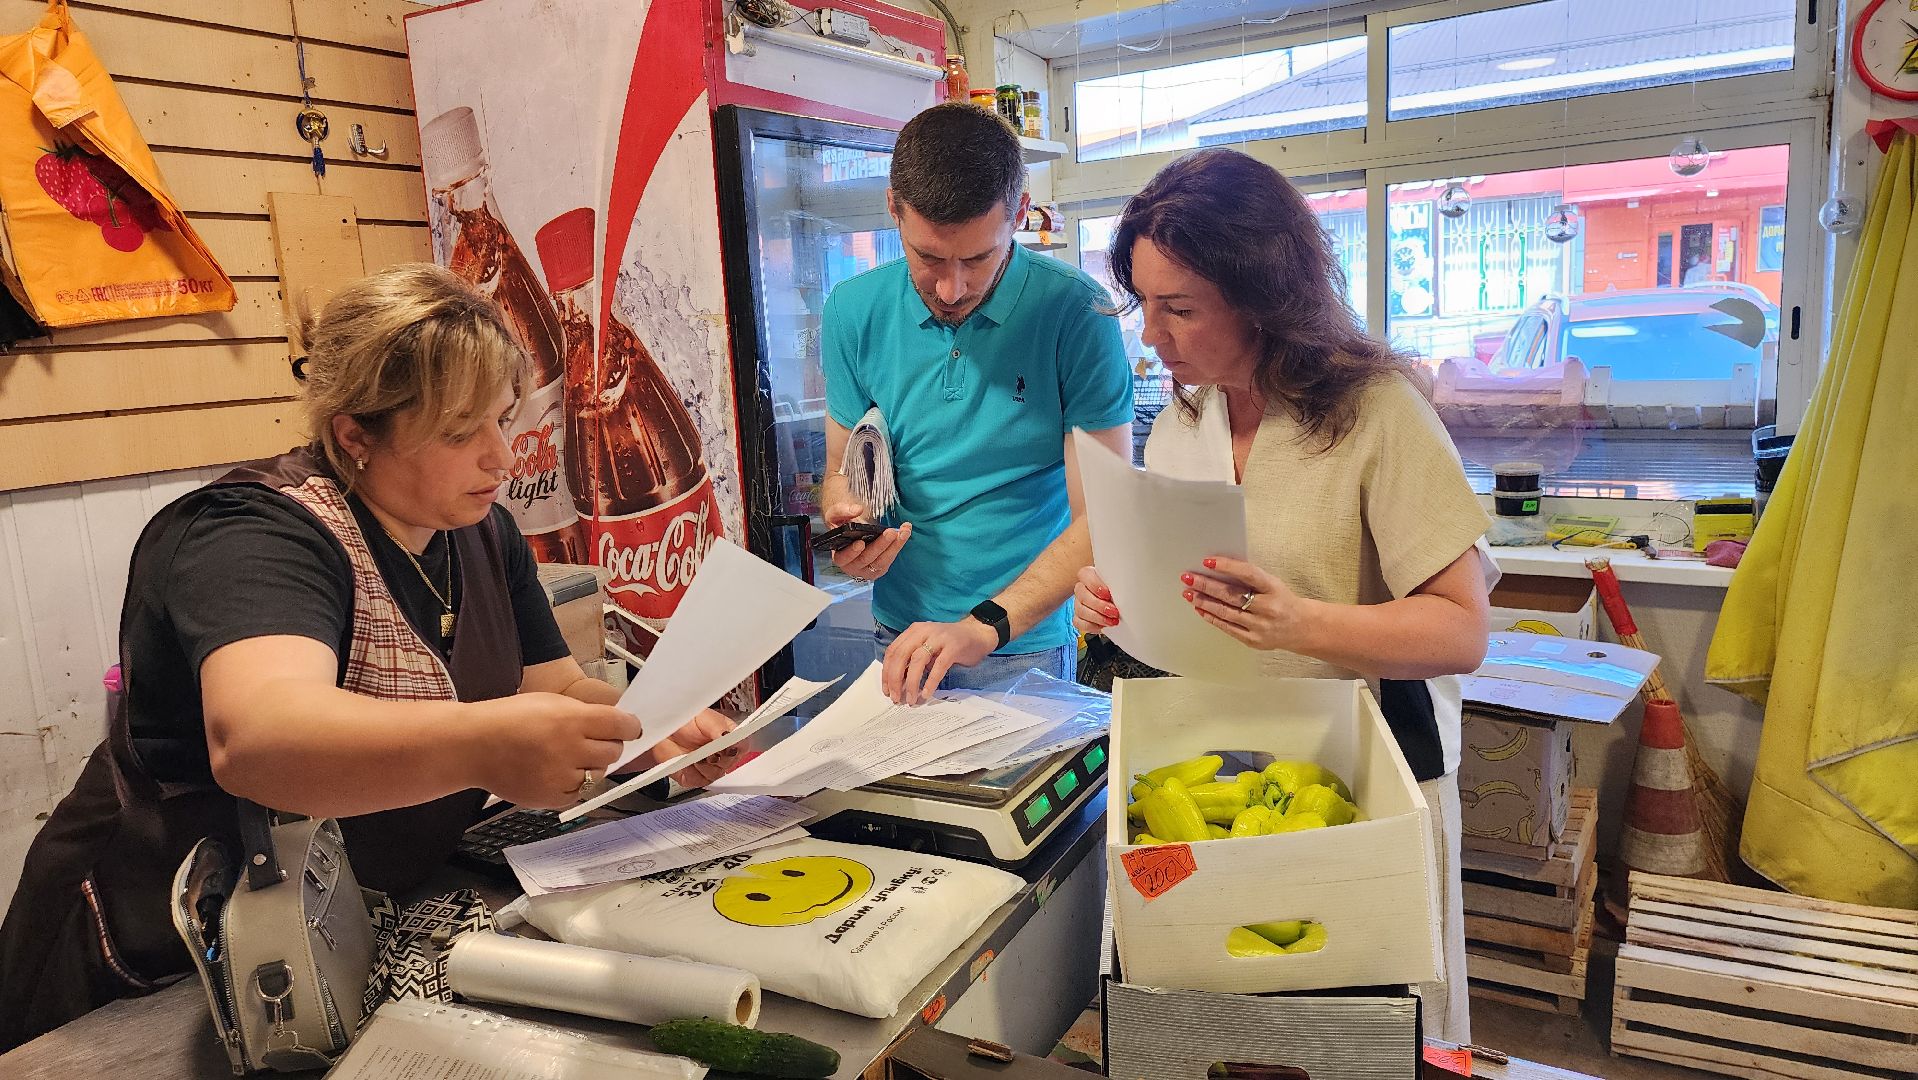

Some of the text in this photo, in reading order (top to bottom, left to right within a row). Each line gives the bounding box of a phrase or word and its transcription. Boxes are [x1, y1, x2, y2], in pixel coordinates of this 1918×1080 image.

[509, 421, 558, 481] Cola
[506, 470, 558, 509] light
[1144, 859, 1177, 893] 200
[824, 866, 923, 945] Дарим улыбку!
[850, 930, 880, 955] Сделано
[881, 906, 907, 927] России
